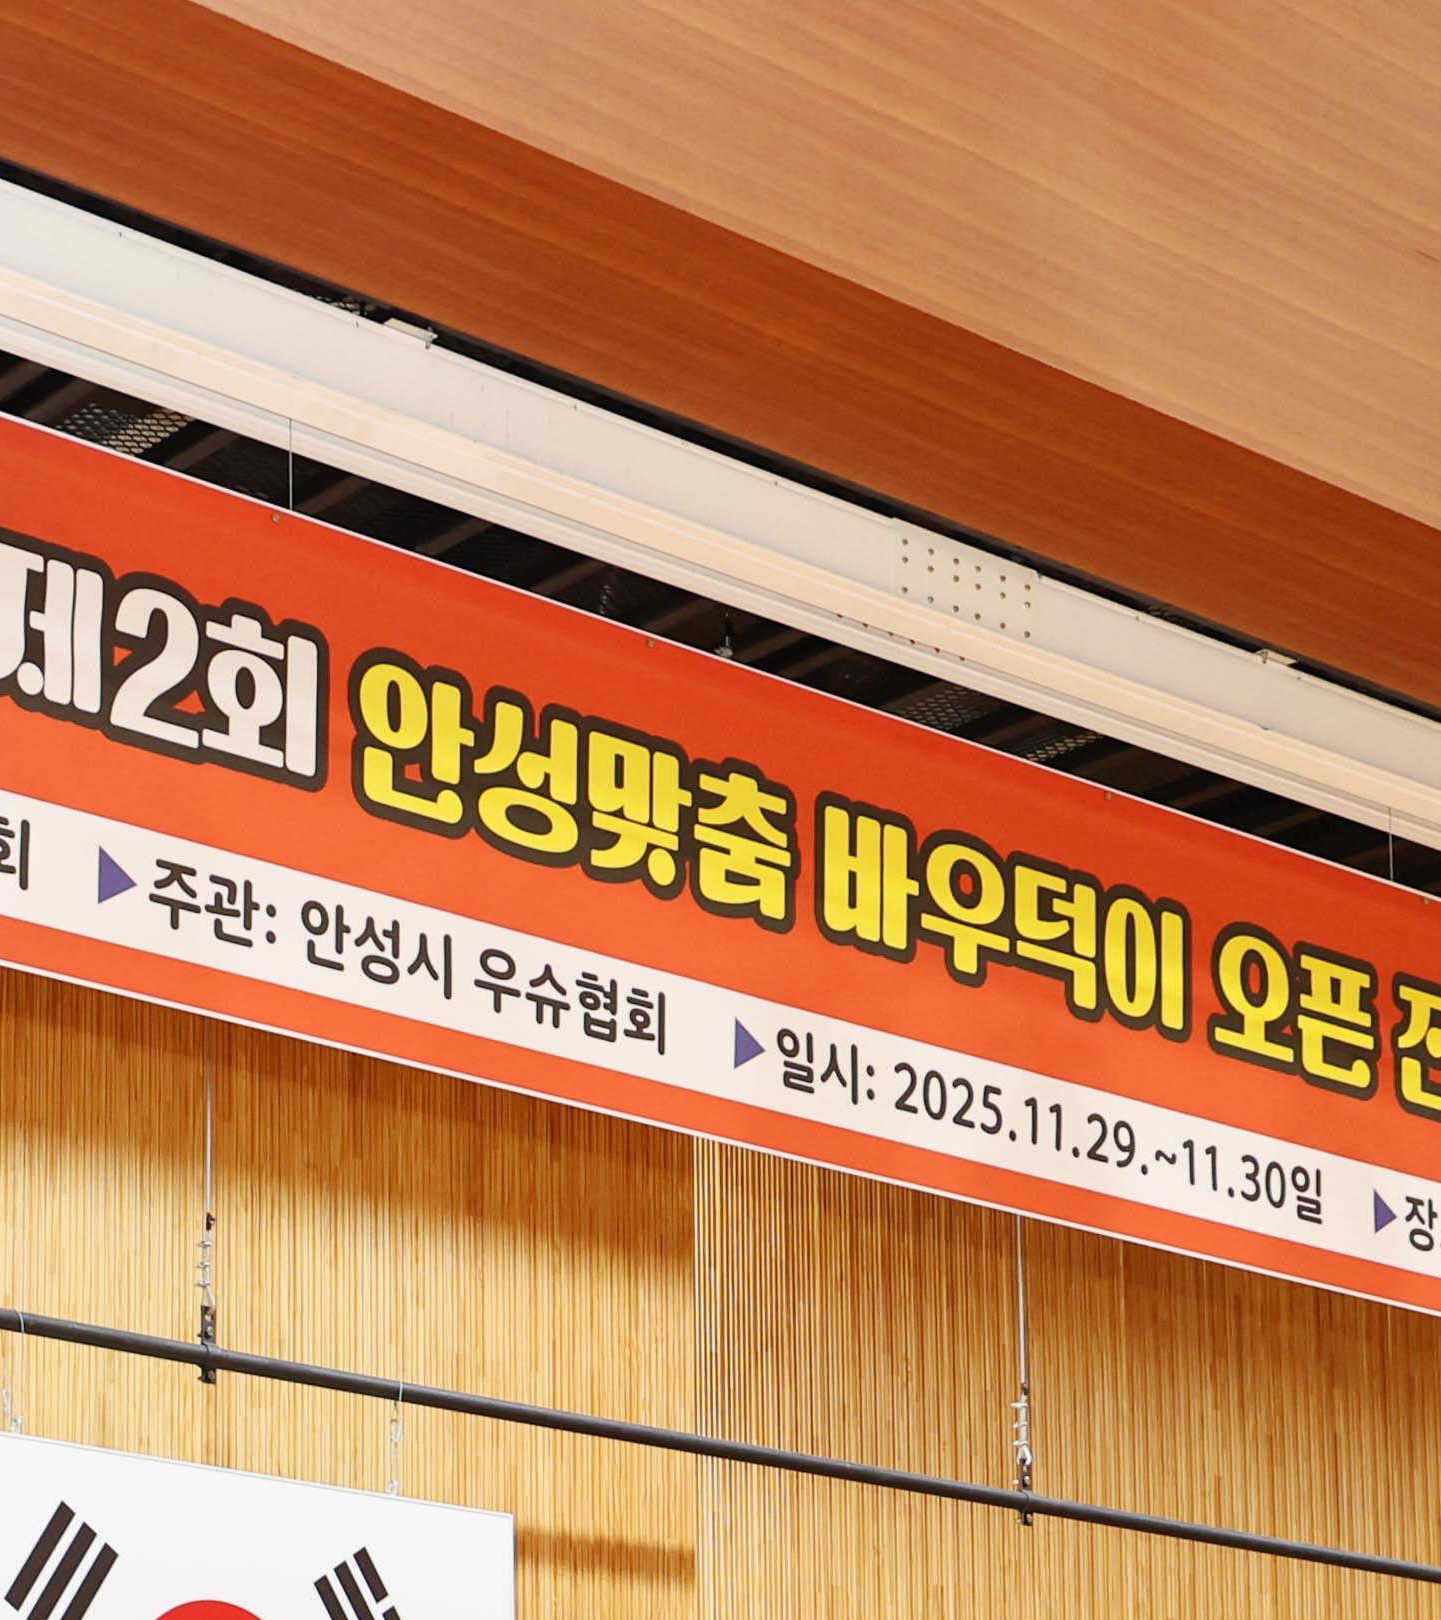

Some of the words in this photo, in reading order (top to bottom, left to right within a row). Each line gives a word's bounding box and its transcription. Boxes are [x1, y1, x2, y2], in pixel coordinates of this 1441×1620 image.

[146, 855, 278, 949] 주관:
[300, 898, 456, 1000] 안성시
[473, 945, 669, 1057] 우슈협회
[774, 1026, 878, 1106] 일시:
[891, 1060, 1325, 1227] 2025.11.29.~11.30일
[355, 660, 795, 922] 안성맞춤
[820, 800, 1187, 1036] 바우덕이
[1210, 930, 1379, 1092] 오픈
